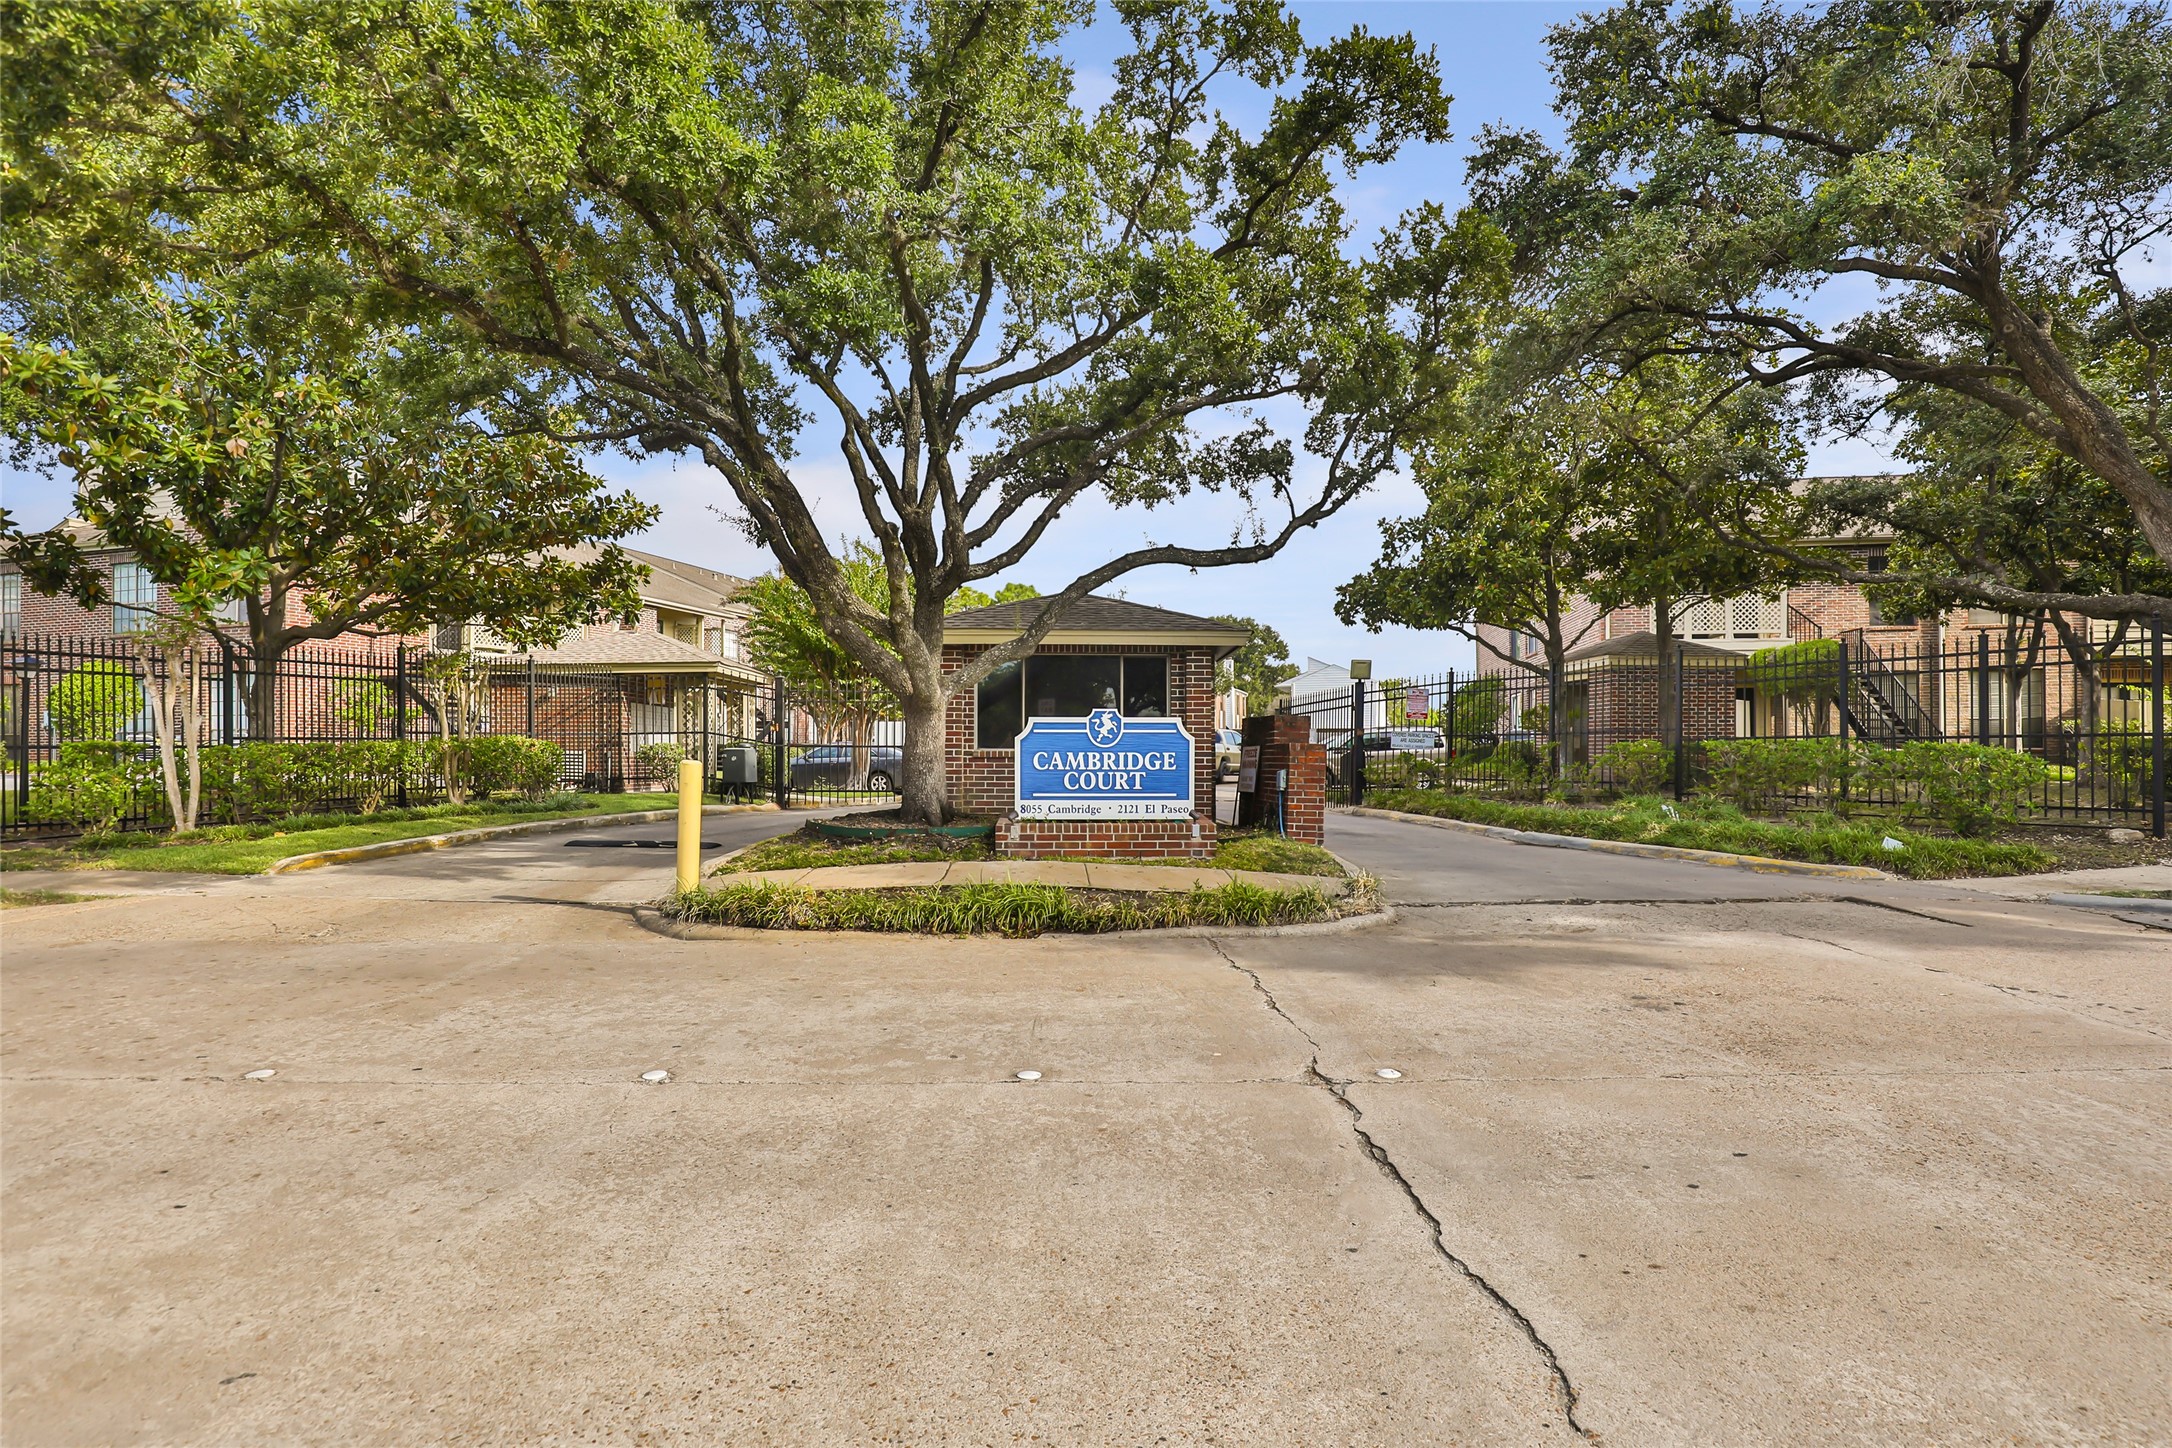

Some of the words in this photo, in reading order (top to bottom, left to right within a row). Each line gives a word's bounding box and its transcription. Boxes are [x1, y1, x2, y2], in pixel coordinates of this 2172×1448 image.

[1032, 751, 1177, 771] CAMBRIDGE
[1063, 771, 1147, 790] COURT
[1020, 804, 1043, 814] 8055
[1048, 804, 1102, 815] Cambridge
[1117, 804, 1139, 814] 2121
[1145, 804, 1156, 814] El
[1161, 804, 1189, 814] Paseo
